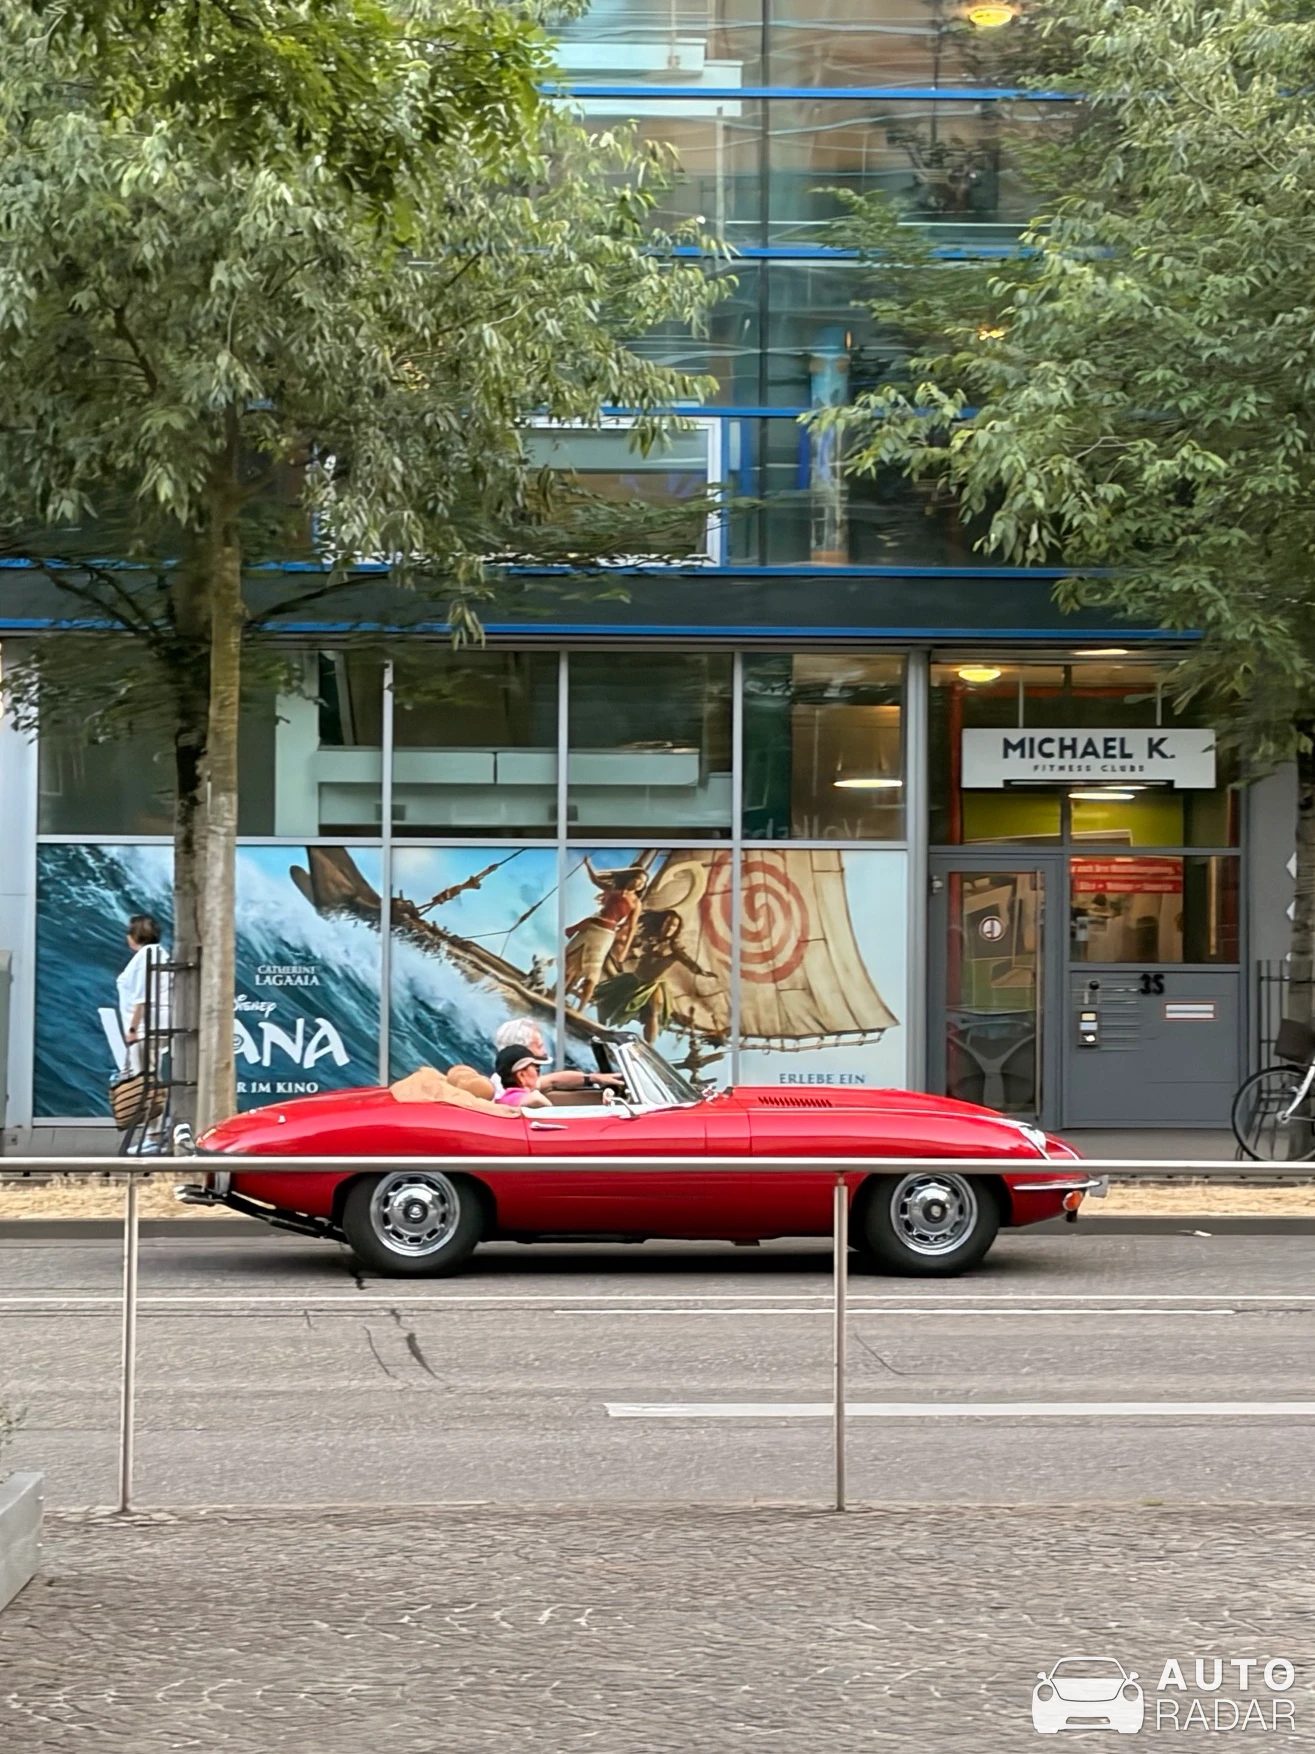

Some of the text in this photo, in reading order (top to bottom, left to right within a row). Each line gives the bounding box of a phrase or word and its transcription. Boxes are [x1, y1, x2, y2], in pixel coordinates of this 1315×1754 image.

[1002, 736, 1176, 760] MICHAEL K.
[1033, 764, 1144, 772] FITNESS CLUBS
[1140, 973, 1164, 995] 35
[233, 994, 277, 1018] isney
[250, 1081, 271, 1093] IM
[276, 1081, 319, 1093] KINO
[779, 1073, 866, 1084] ERLEBE EIN
